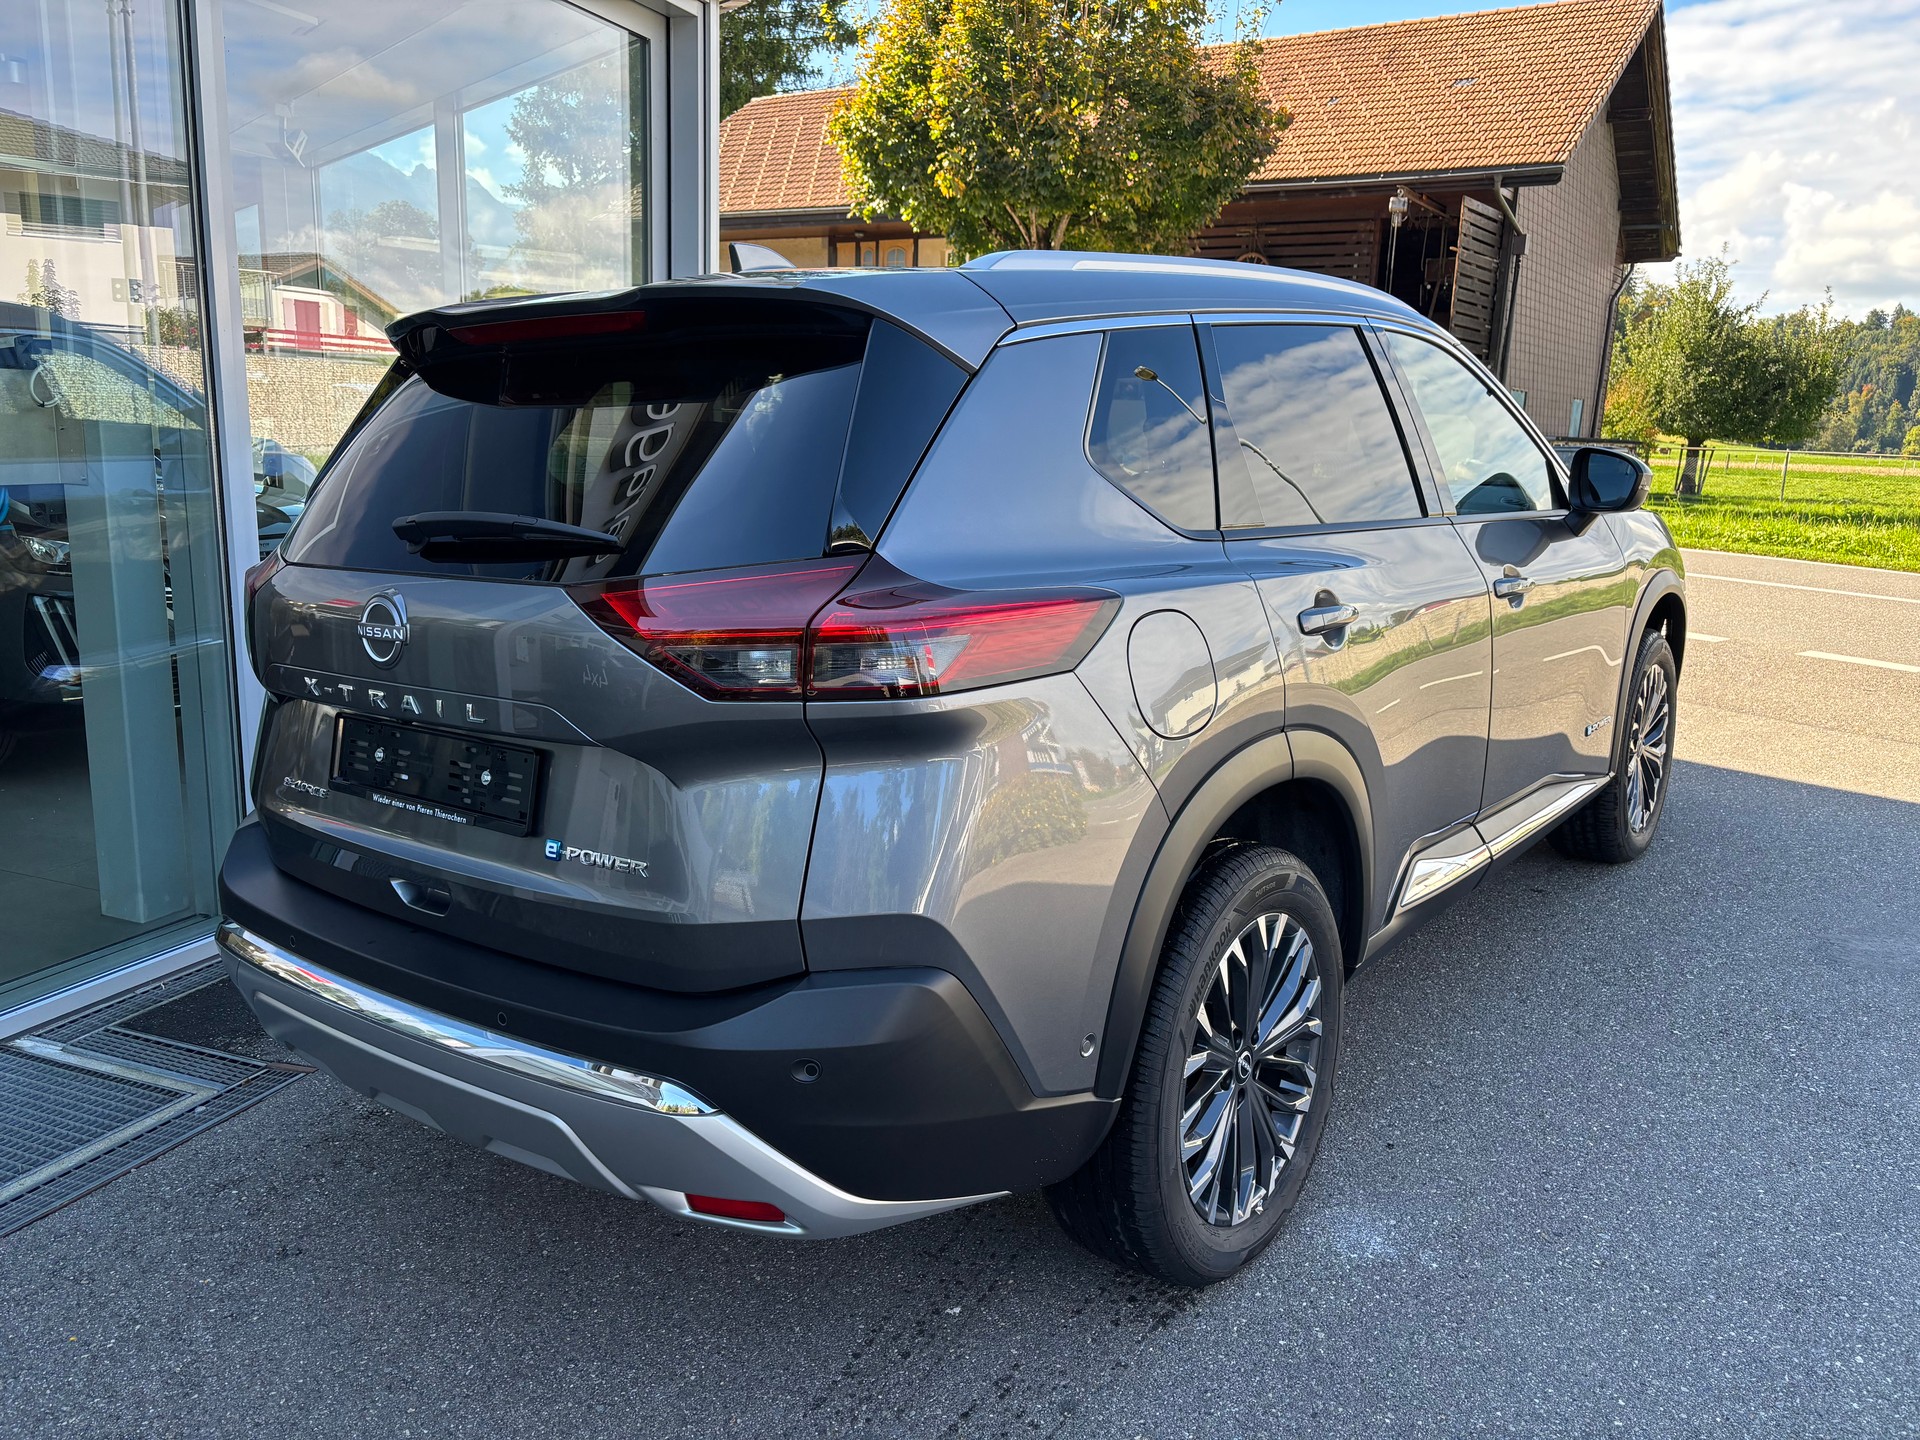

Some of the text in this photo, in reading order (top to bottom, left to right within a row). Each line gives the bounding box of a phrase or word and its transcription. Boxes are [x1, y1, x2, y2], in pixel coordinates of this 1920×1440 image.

[357, 625, 404, 640] NISSAN
[304, 676, 486, 724] X-TRAIL
[372, 793, 391, 805] Wieder
[391, 799, 405, 809] einer
[406, 803, 415, 811] von
[416, 804, 433, 816] Pieren
[545, 839, 649, 878] e-POWER
